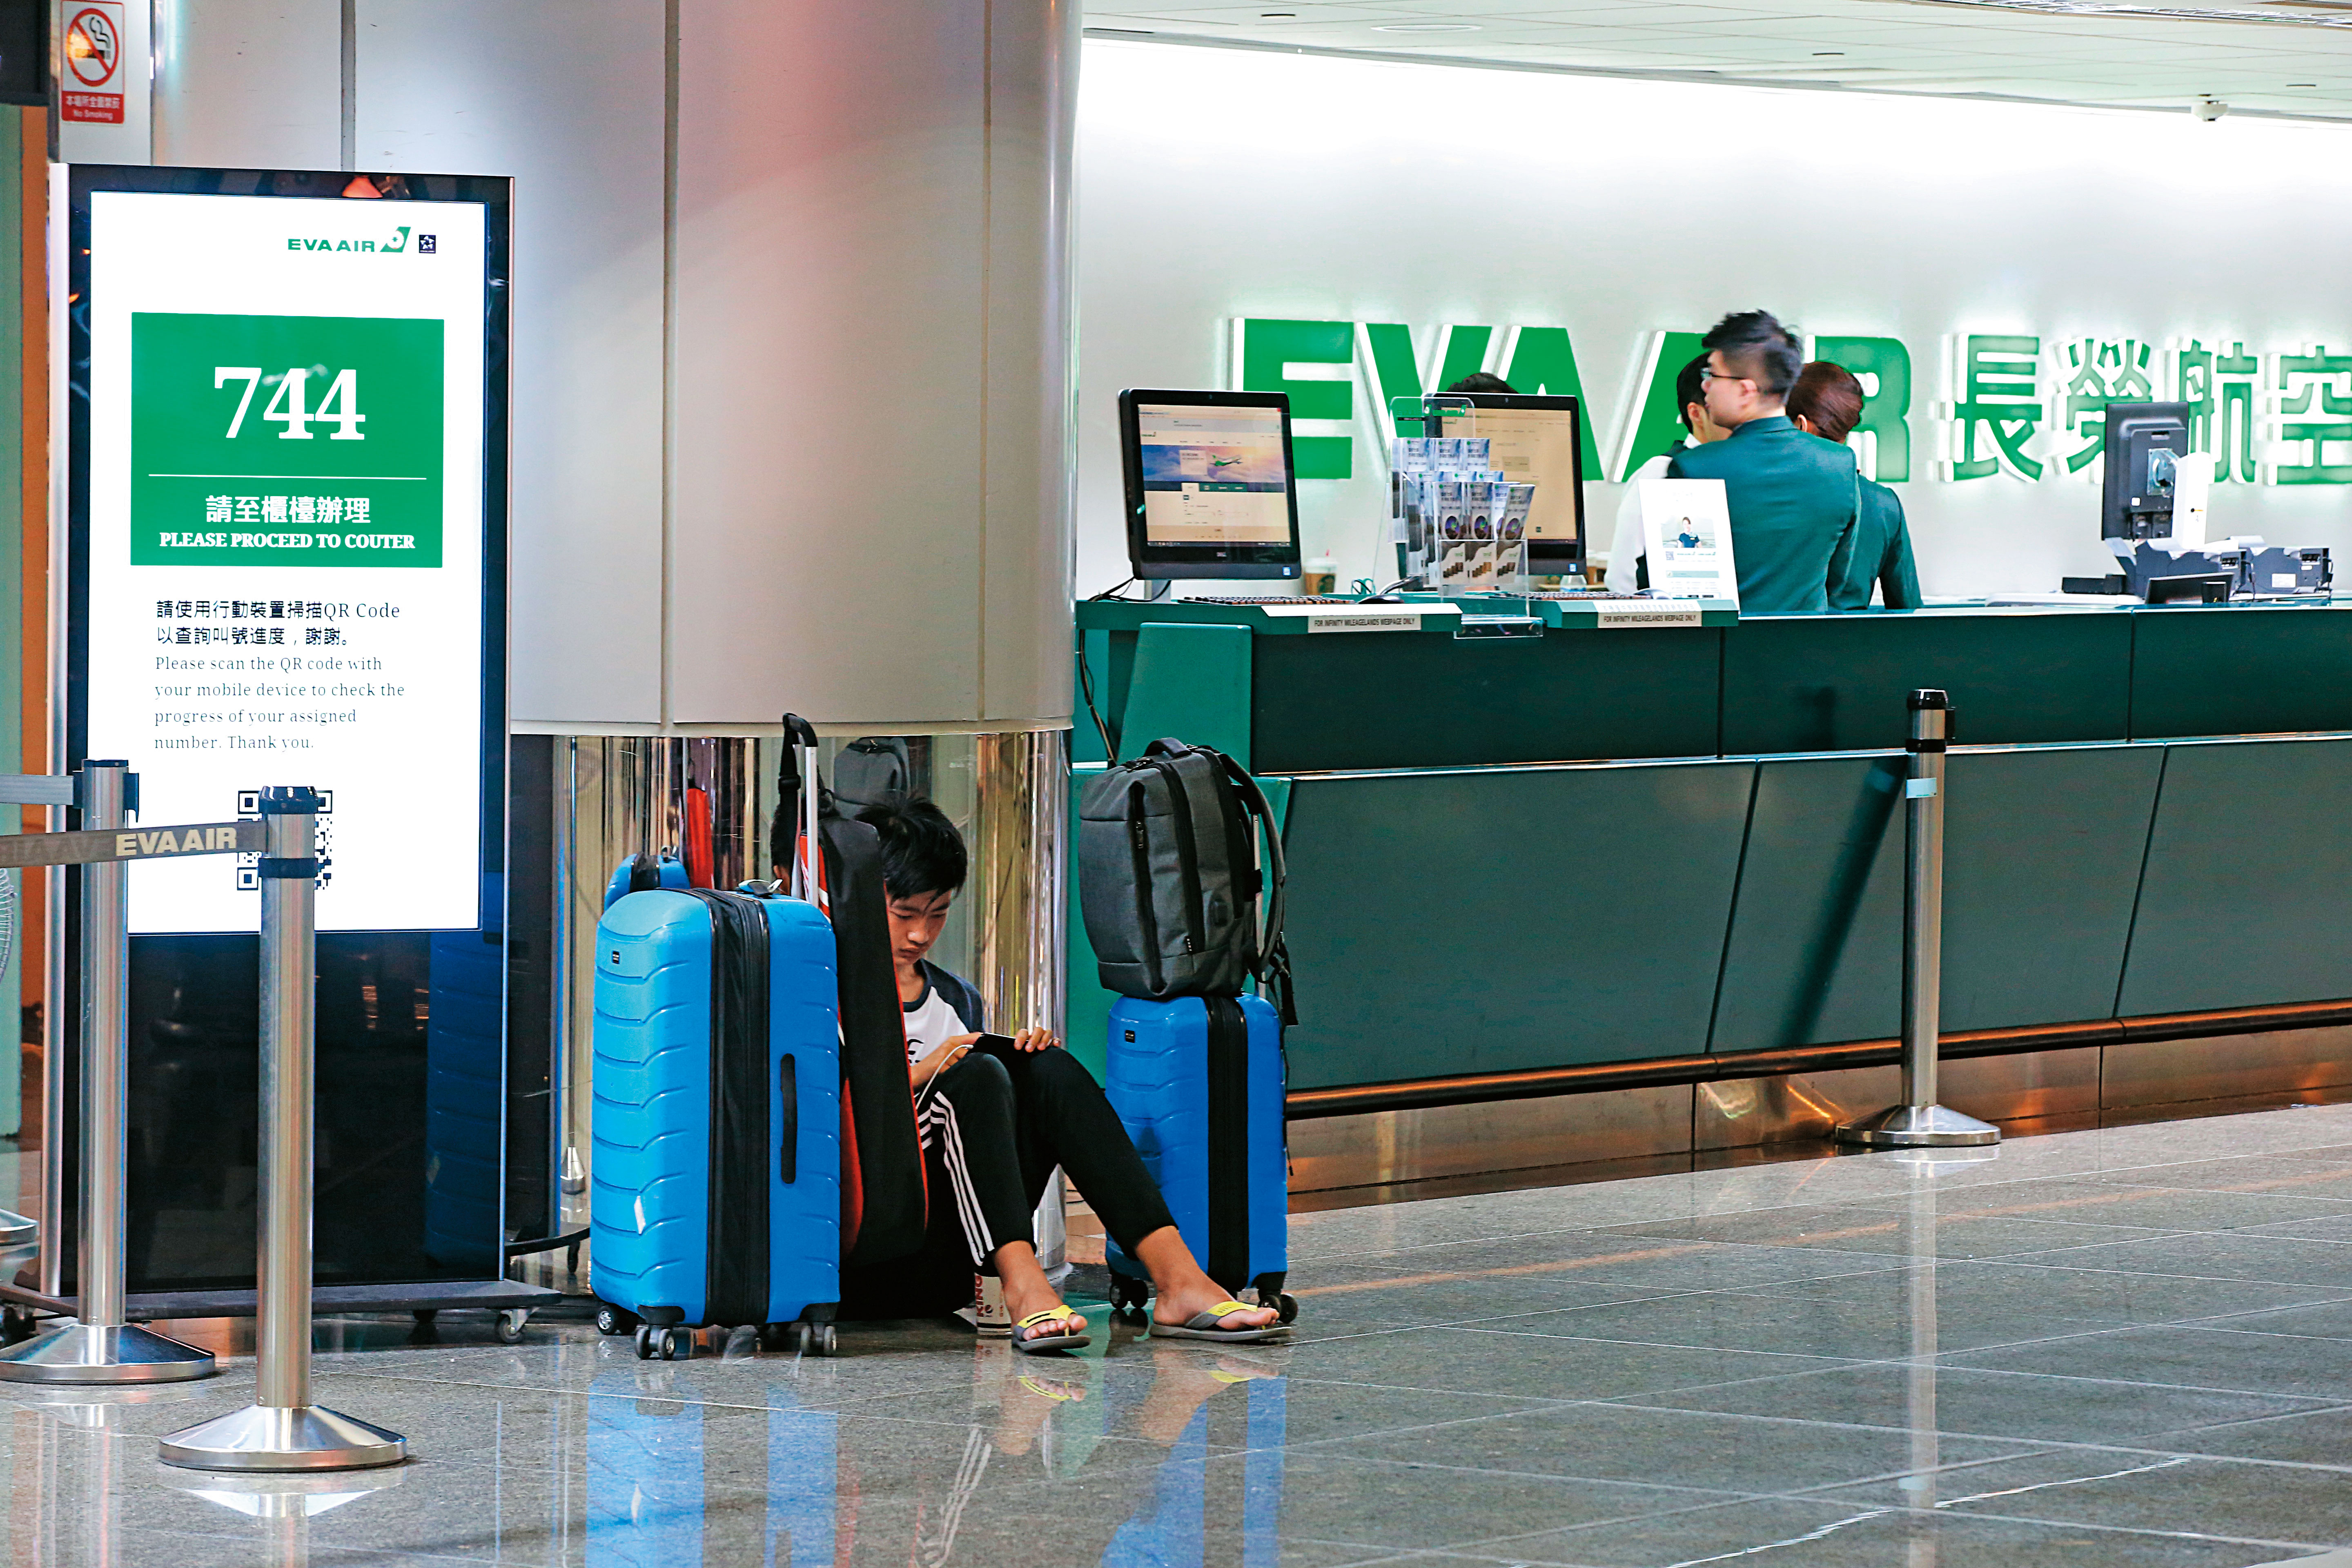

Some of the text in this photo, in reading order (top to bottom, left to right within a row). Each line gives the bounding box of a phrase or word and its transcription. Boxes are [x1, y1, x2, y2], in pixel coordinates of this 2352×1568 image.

[215, 367, 365, 440] 744
[160, 532, 416, 548] PLEASE PROCEED TO COUTER
[356, 603, 400, 618] Code
[156, 657, 382, 674] Please scan the QR code with
[155, 683, 404, 700] your mobile device to check the
[155, 710, 356, 726] progress of your assigned
[155, 736, 313, 752] number. Thank you.
